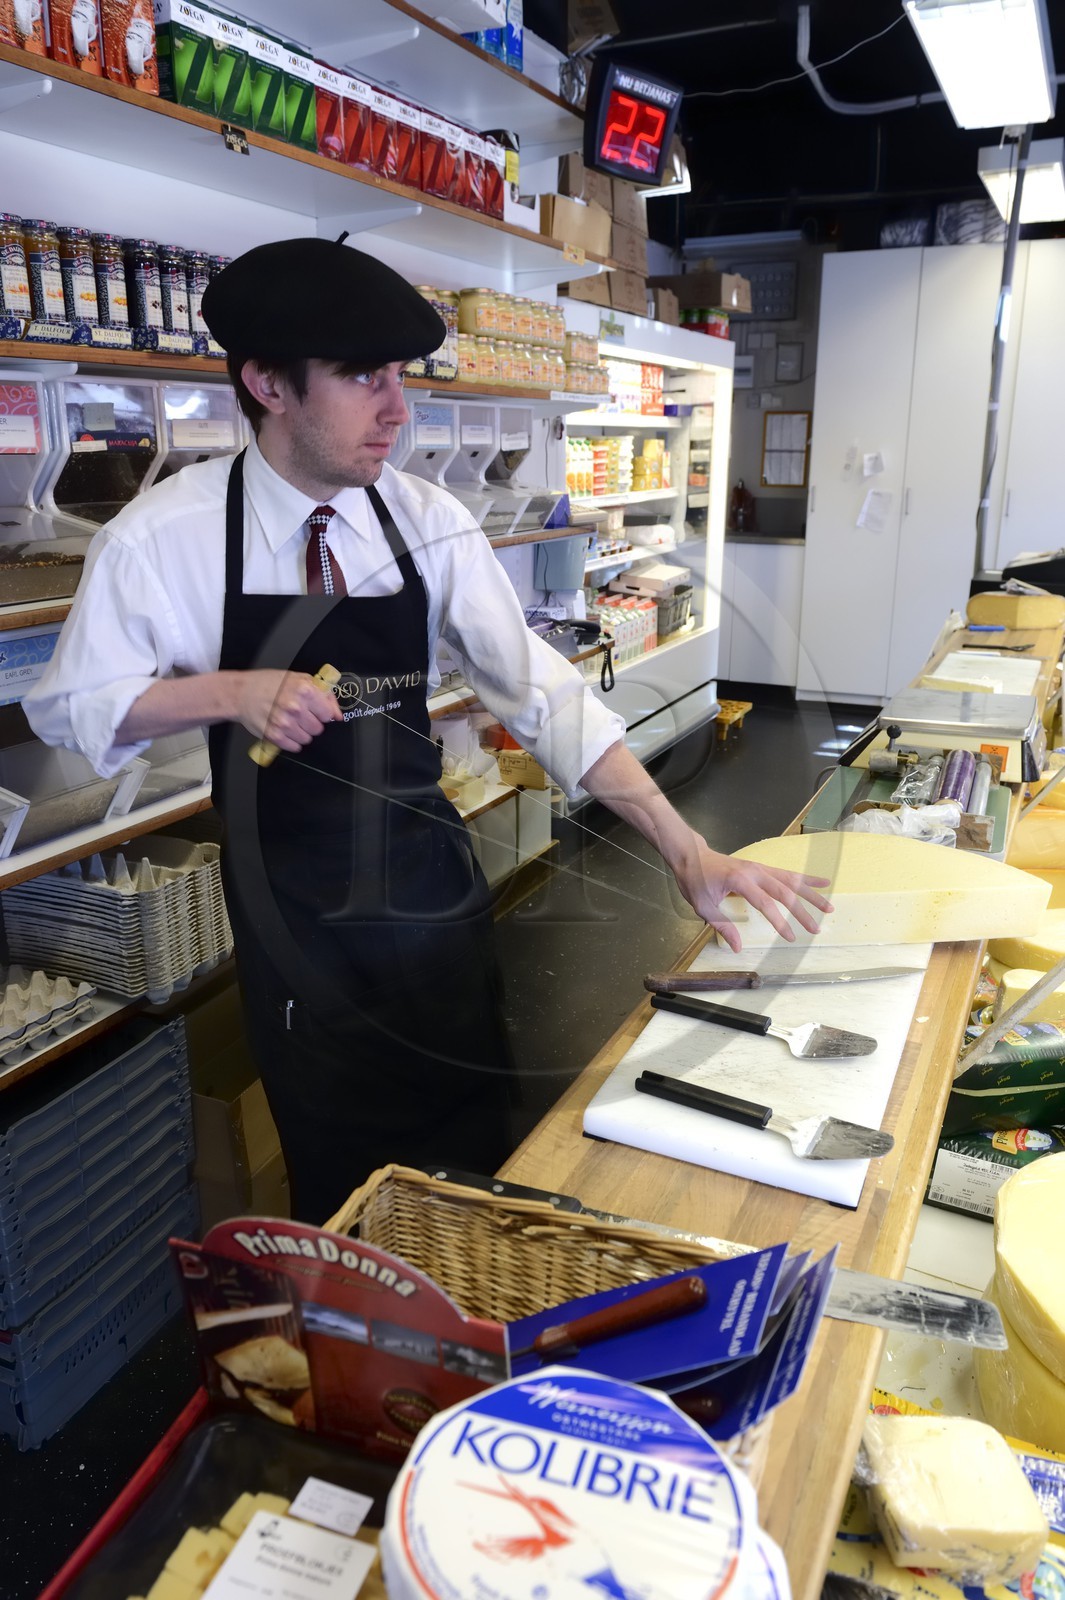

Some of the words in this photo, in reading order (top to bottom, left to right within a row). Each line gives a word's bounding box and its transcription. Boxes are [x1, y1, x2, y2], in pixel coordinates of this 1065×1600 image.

[601, 96, 666, 169] 22
[366, 670, 421, 694] DAVID
[386, 700, 402, 711] 1969
[450, 1418, 719, 1524] KOLIBRIE
